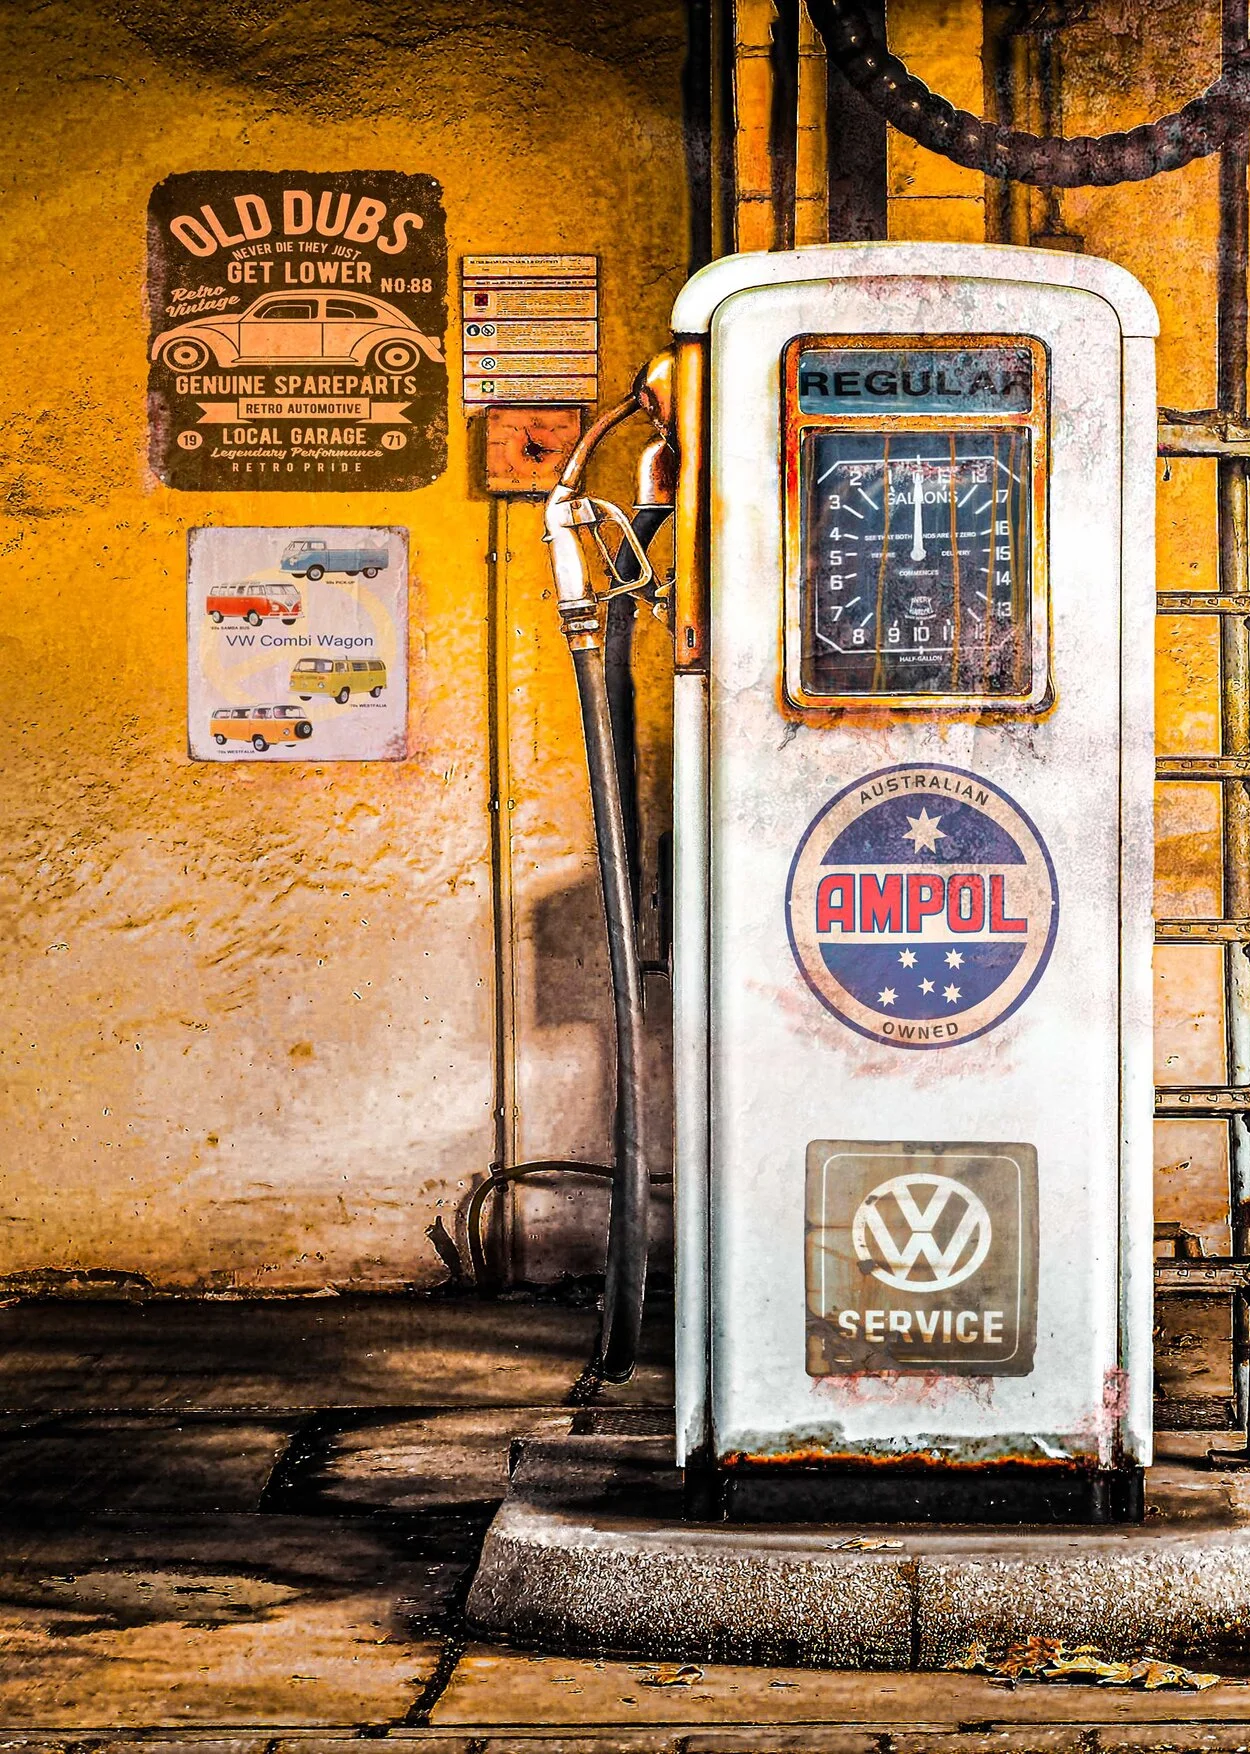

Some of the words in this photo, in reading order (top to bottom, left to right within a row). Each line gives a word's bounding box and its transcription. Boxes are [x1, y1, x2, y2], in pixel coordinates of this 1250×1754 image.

[169, 194, 272, 257] OLD
[283, 190, 424, 255] DUBS
[232, 243, 272, 261] NEVER
[275, 241, 294, 253] DIE
[298, 241, 328, 254] THEY
[331, 245, 362, 261] JUST
[227, 261, 274, 284] GET
[284, 261, 372, 284] LOWER
[170, 284, 226, 303] Retro
[165, 295, 241, 318] Vintage
[175, 375, 266, 395] GENUINE
[274, 375, 417, 395] SPAREPARTS
[800, 370, 1030, 397] REGULAR
[245, 403, 283, 414] RETRO
[287, 403, 362, 414] AUTOMOTIVE
[183, 434, 197, 446] 19
[222, 427, 283, 445] LOCAL
[290, 427, 367, 445] GARAGE
[386, 434, 401, 447] 71
[210, 447, 287, 460] Legendary
[290, 447, 384, 460] Performance
[232, 462, 294, 472] RETRO
[303, 462, 362, 472] PRIDE
[849, 469, 862, 486] 2
[829, 495, 841, 510] 3
[886, 491, 958, 506] GALONS
[995, 489, 1009, 504] 17
[829, 527, 842, 541] 4
[994, 520, 1010, 536] 16
[829, 550, 843, 566] 5
[995, 546, 1011, 561] 15
[830, 574, 843, 591] 6
[995, 571, 1012, 586] 14
[830, 606, 843, 622] 7
[996, 601, 1012, 617] 13
[226, 634, 255, 647] VW
[260, 634, 312, 647] Combi
[317, 634, 373, 650] Wagon
[852, 628, 865, 645] 8
[888, 627, 900, 643] 9
[913, 626, 930, 642] 10
[859, 774, 990, 806] AUSTRALIAN
[816, 873, 1028, 934] AMPOL
[882, 1022, 959, 1040] OWNED
[855, 1175, 990, 1291] VW
[838, 1310, 1004, 1344] SERVICE
